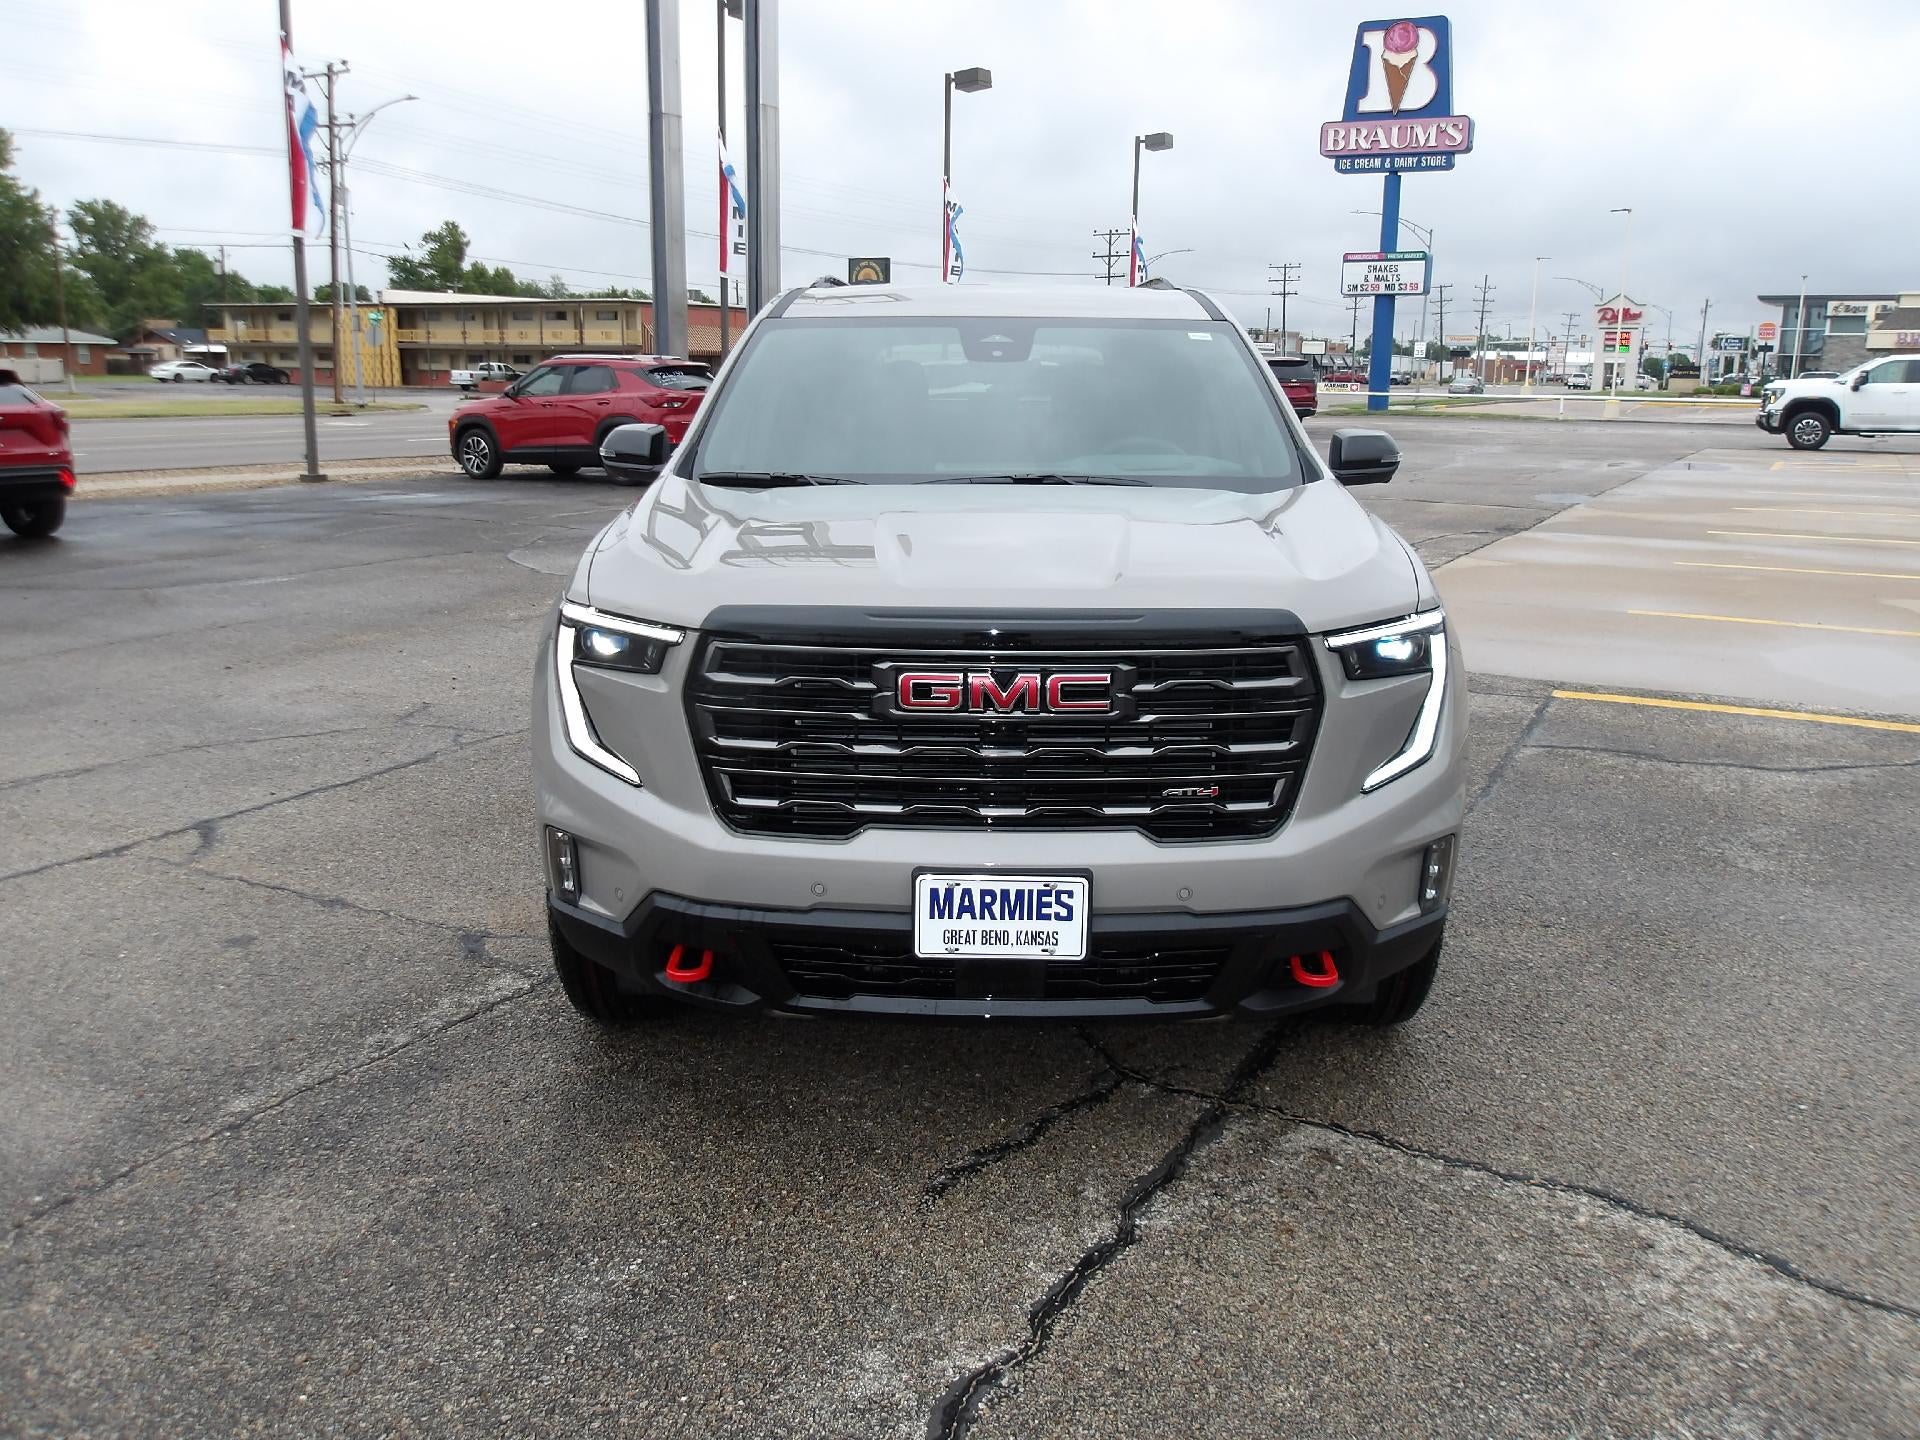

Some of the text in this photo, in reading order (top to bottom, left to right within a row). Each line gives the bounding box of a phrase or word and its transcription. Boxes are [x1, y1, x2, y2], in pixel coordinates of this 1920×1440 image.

[1325, 120, 1464, 151] BRAUM'S
[1339, 155, 1447, 170] ICE CREAM & DAIRY STORE
[1367, 264, 1399, 273] SHAKES
[1373, 273, 1401, 282] MALTS
[1347, 284, 1358, 292] SM
[898, 671, 1111, 712] GMC
[929, 887, 1075, 922] MARMIES
[943, 929, 1059, 948] GREAT BEND, KANSAS
